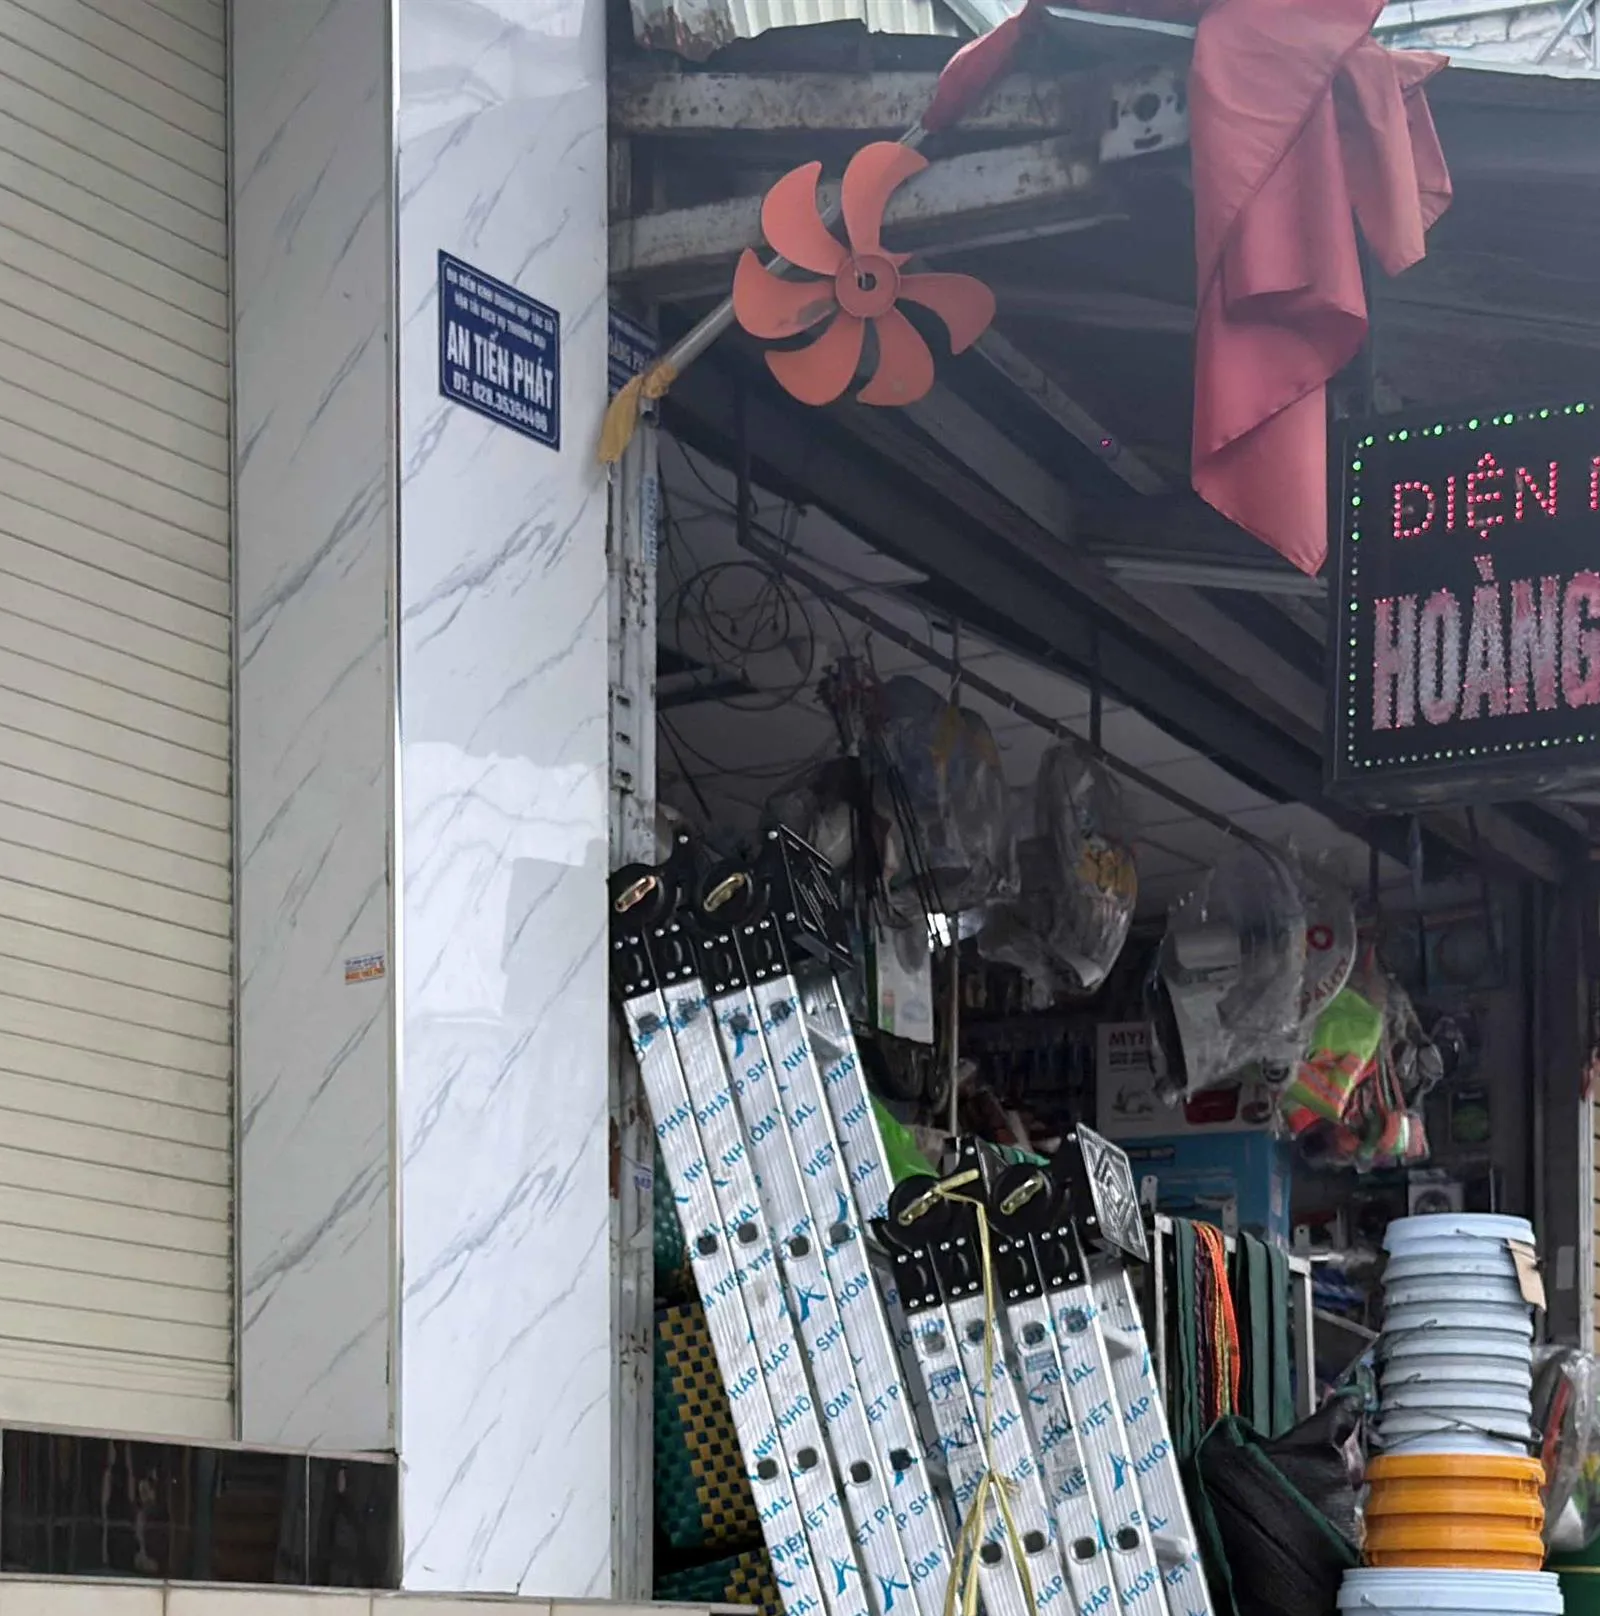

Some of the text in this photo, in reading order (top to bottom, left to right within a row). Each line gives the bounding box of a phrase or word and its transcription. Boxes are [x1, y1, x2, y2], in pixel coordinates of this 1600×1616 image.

[447, 320, 471, 371] AN
[474, 329, 510, 390] TIẾN
[513, 356, 553, 410] PHÁT
